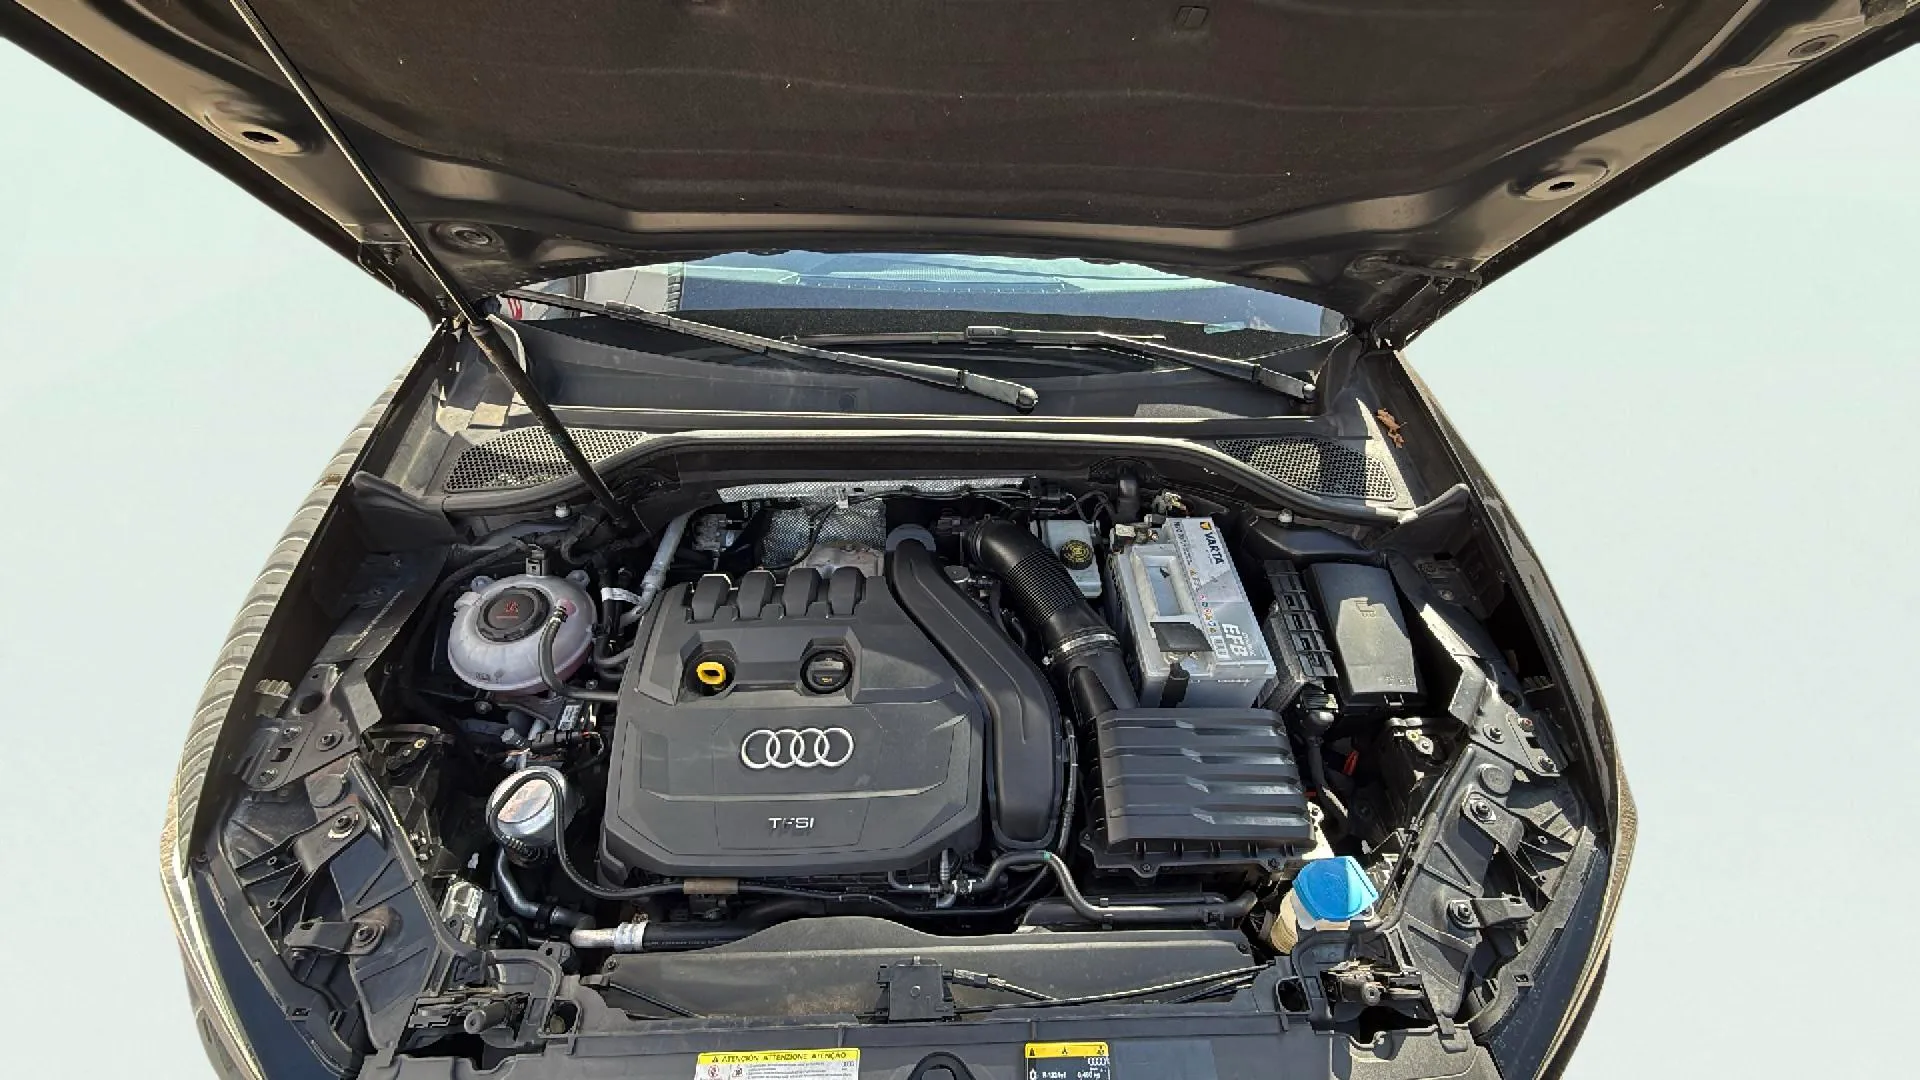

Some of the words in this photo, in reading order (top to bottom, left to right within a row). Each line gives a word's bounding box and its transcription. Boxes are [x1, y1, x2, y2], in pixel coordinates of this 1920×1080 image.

[1204, 531, 1225, 565] VARTA
[1221, 623, 1249, 657] EFB
[768, 817, 815, 829] TFSI
